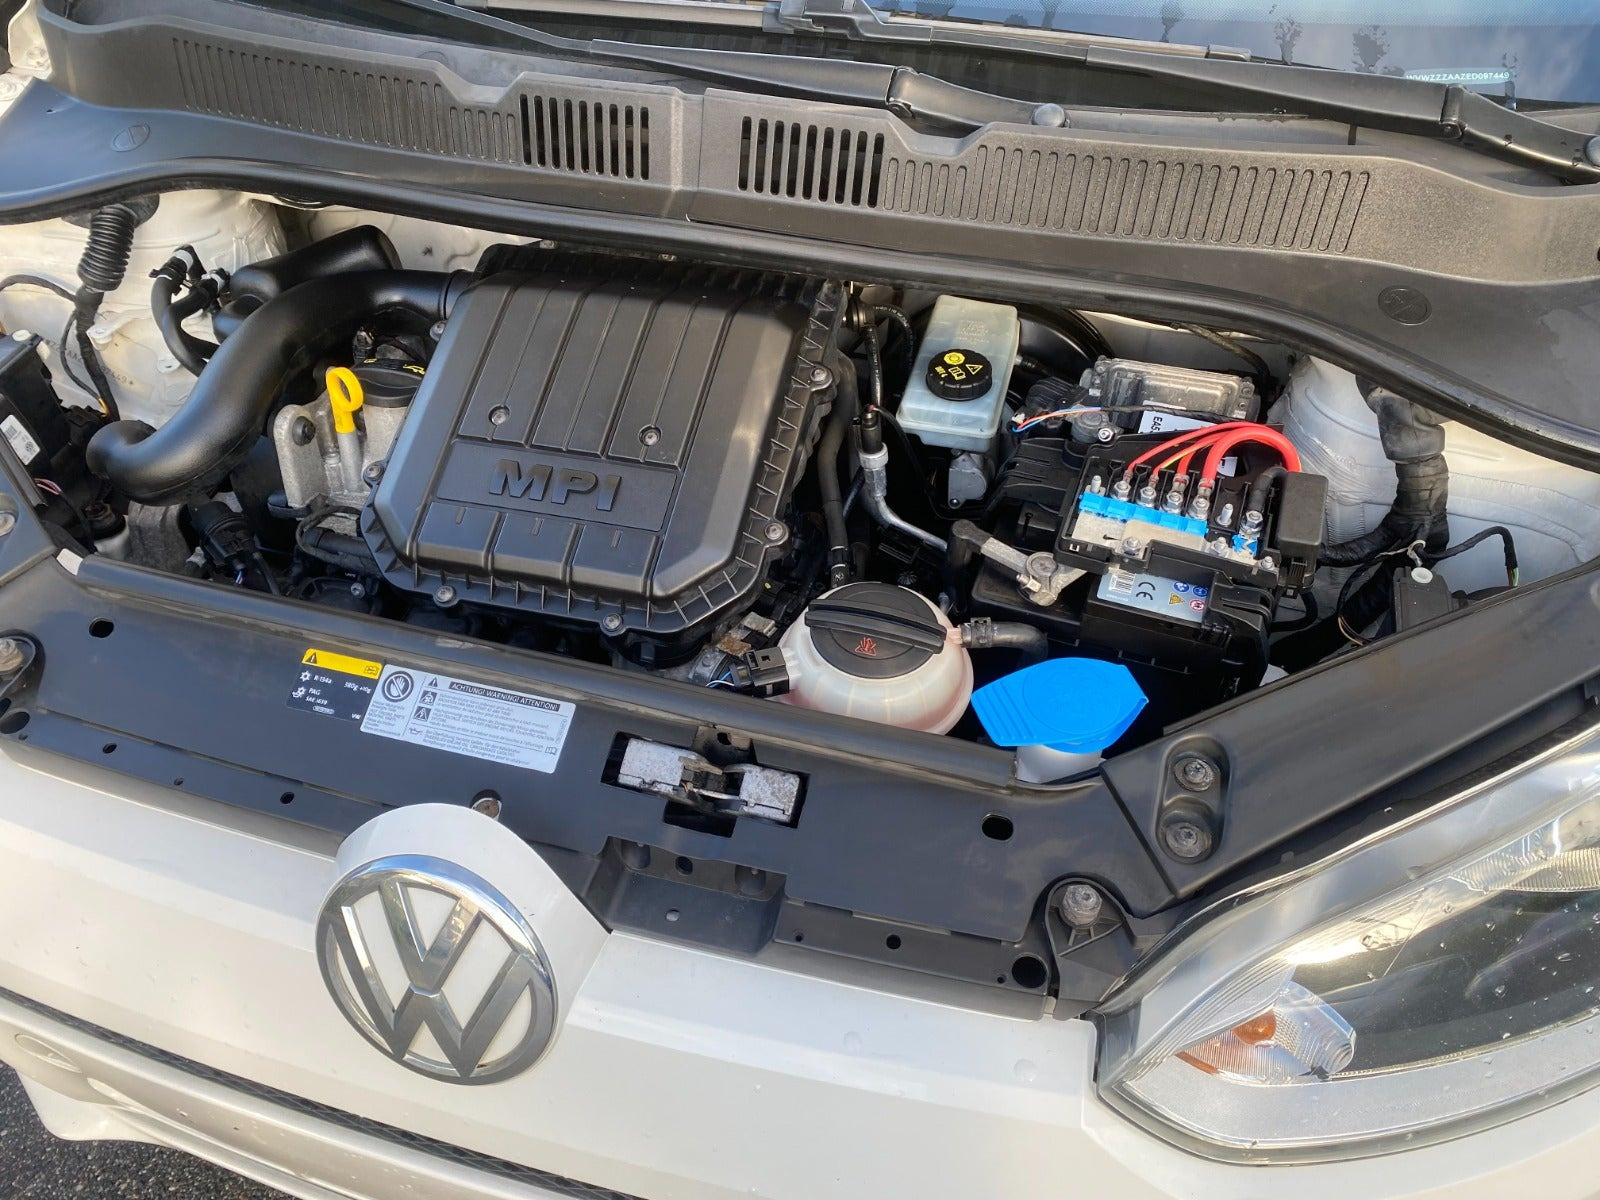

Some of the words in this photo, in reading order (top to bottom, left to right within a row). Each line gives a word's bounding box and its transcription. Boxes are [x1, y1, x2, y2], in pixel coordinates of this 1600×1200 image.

[1149, 416, 1163, 434] EA5
[488, 459, 622, 512] MPI
[308, 687, 321, 696] PAG
[451, 682, 486, 695] ACHTUNG!
[486, 689, 520, 704] WARNING!
[520, 696, 559, 711] ATTENTION!
[316, 855, 558, 1084] VW
